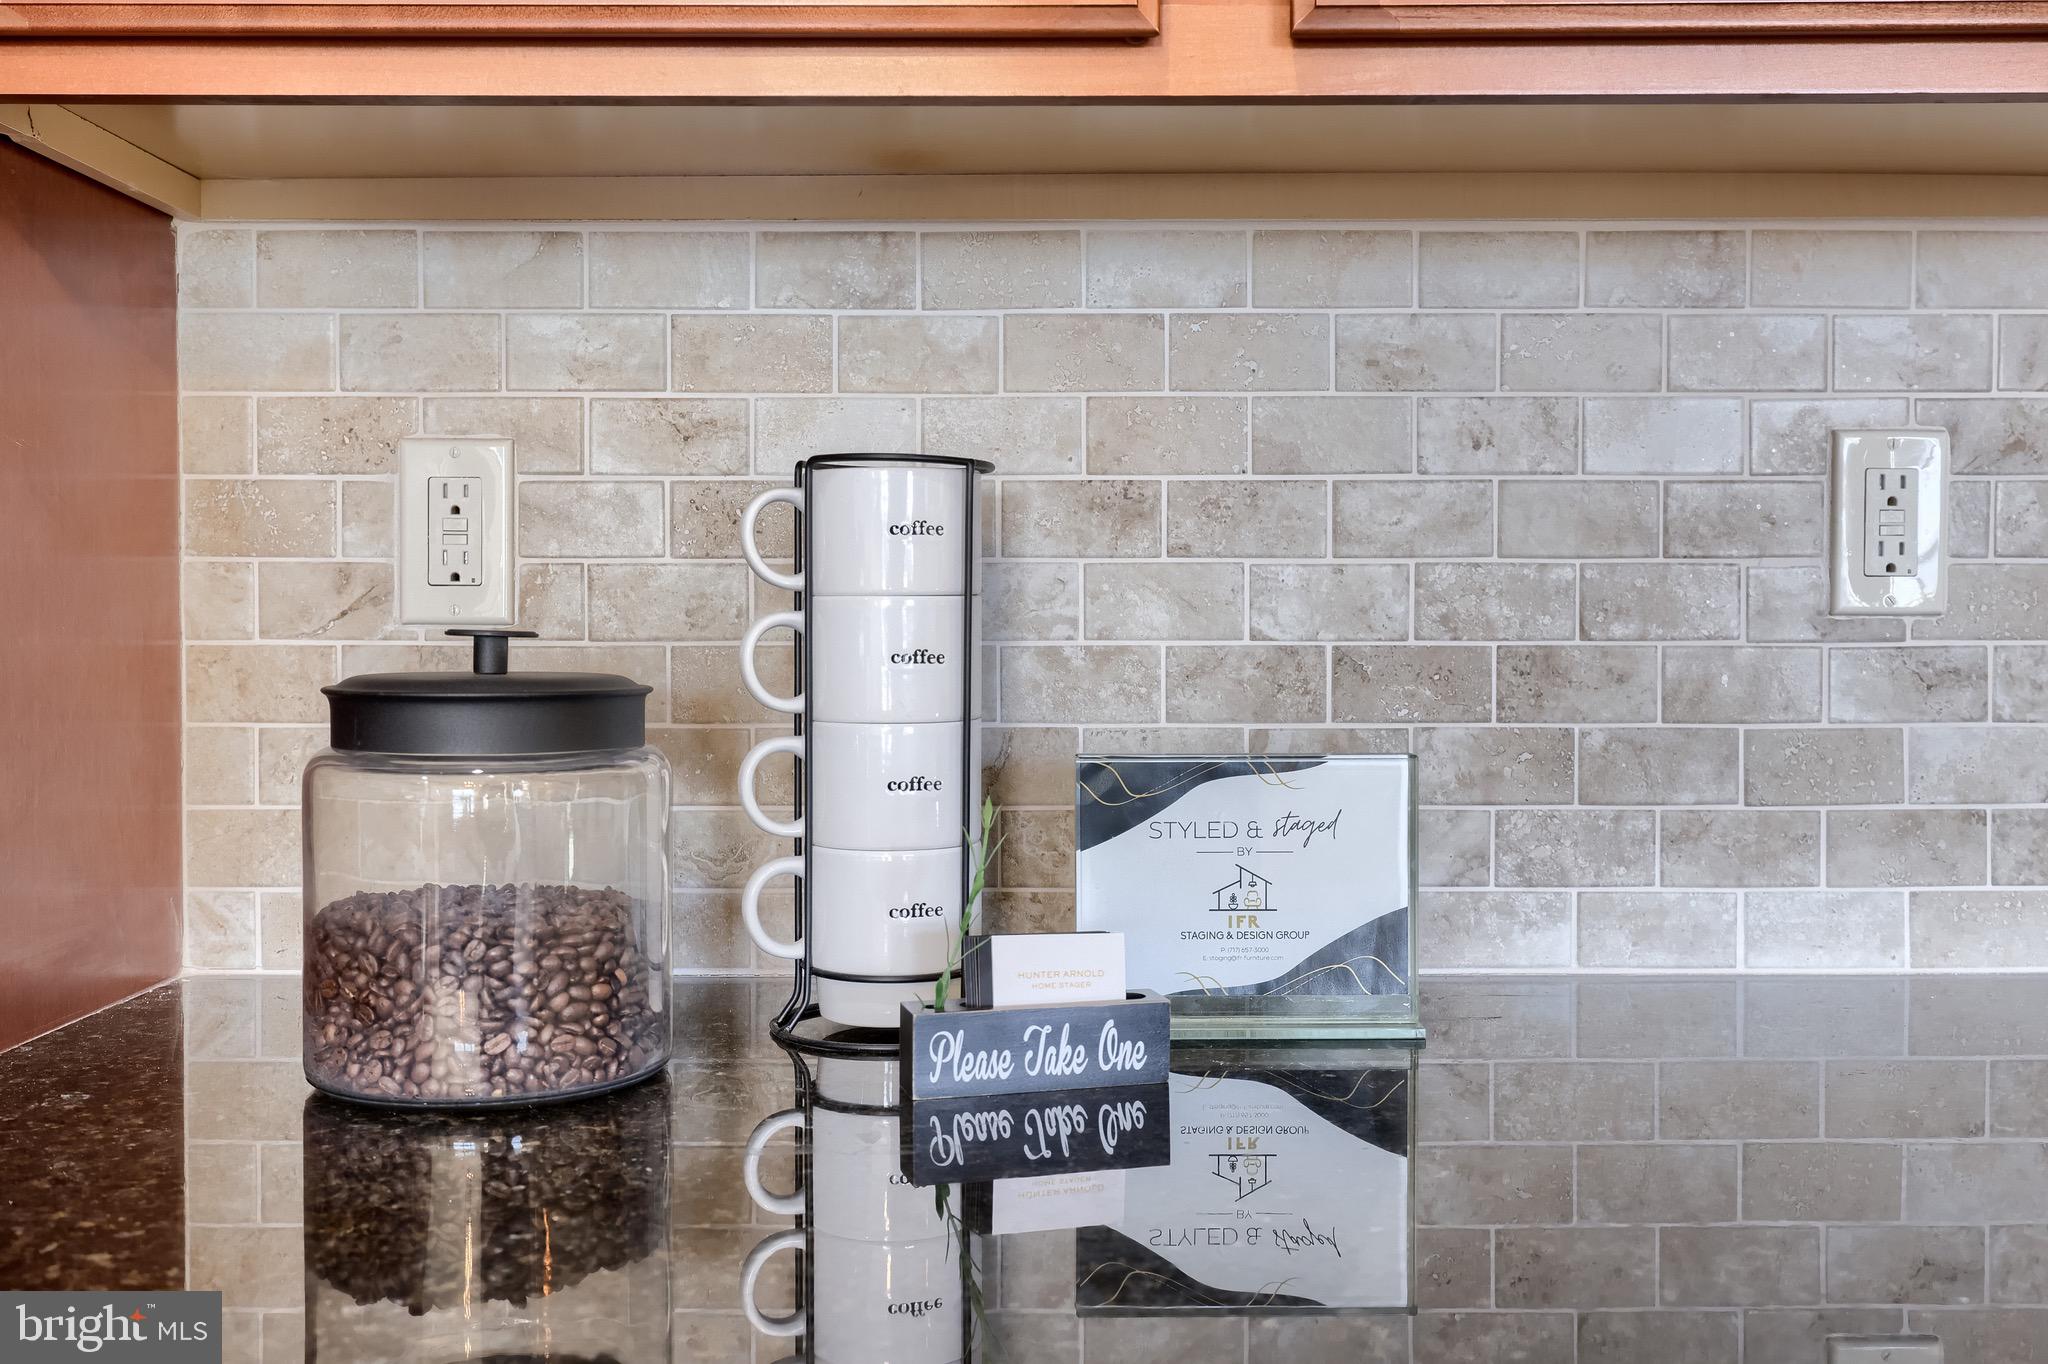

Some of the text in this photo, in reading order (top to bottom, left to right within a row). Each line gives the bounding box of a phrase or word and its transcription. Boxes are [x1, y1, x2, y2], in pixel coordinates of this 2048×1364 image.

[889, 520, 944, 536] coffee
[891, 649, 945, 664] coffee
[887, 776, 942, 792] coffee
[1149, 809, 1342, 848] STYLED & staged
[1236, 847, 1253, 857] BY
[889, 903, 943, 918] coffee
[1228, 915, 1260, 928] IFR
[1180, 930, 1310, 940] STAGING & DESIGN GROUP
[1017, 969, 1104, 979] HUNTER ARNOLD
[1031, 981, 1091, 990] HOME STAGER
[929, 1019, 1147, 1083] Please Take One
